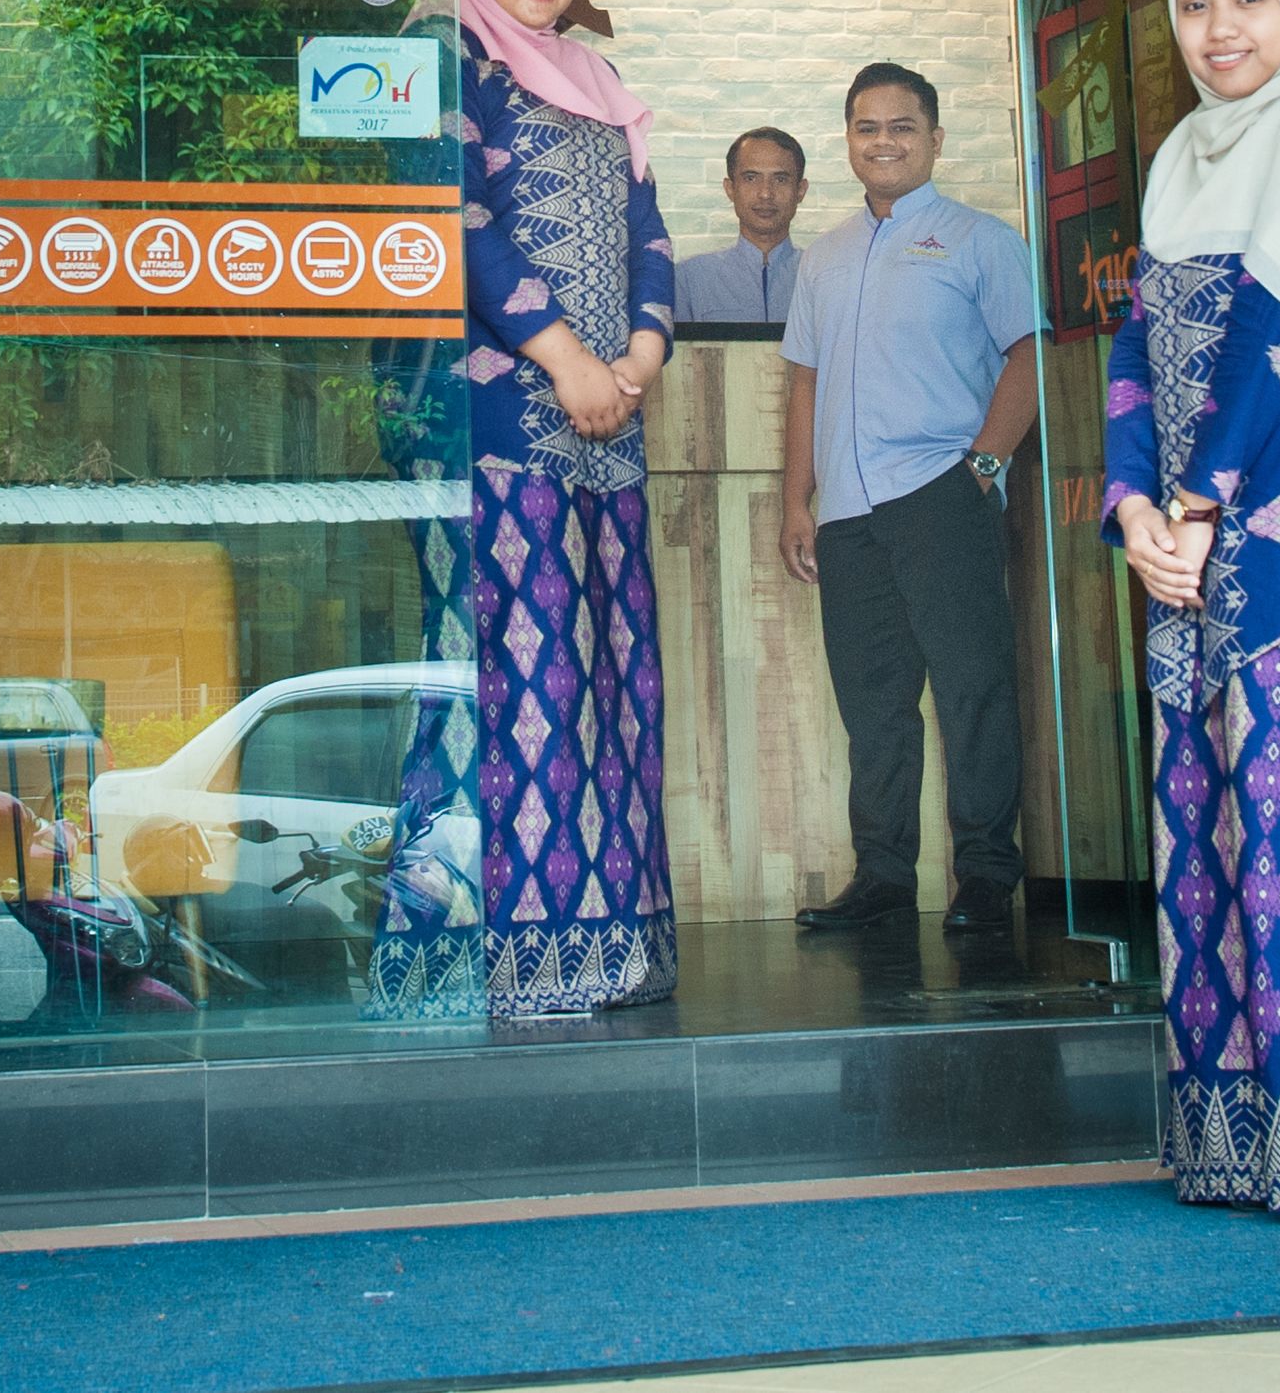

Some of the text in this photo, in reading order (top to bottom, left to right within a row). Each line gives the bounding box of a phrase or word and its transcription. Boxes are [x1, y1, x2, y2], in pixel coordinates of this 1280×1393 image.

[357, 118, 389, 132] 2017
[141, 260, 185, 270] ATTACHED
[226, 263, 265, 273] 24 CCTV
[381, 264, 437, 274] ACCESS CARD
[229, 272, 263, 282] HOURS
[312, 270, 345, 279] ASTRO
[390, 273, 429, 283] CONTROL
